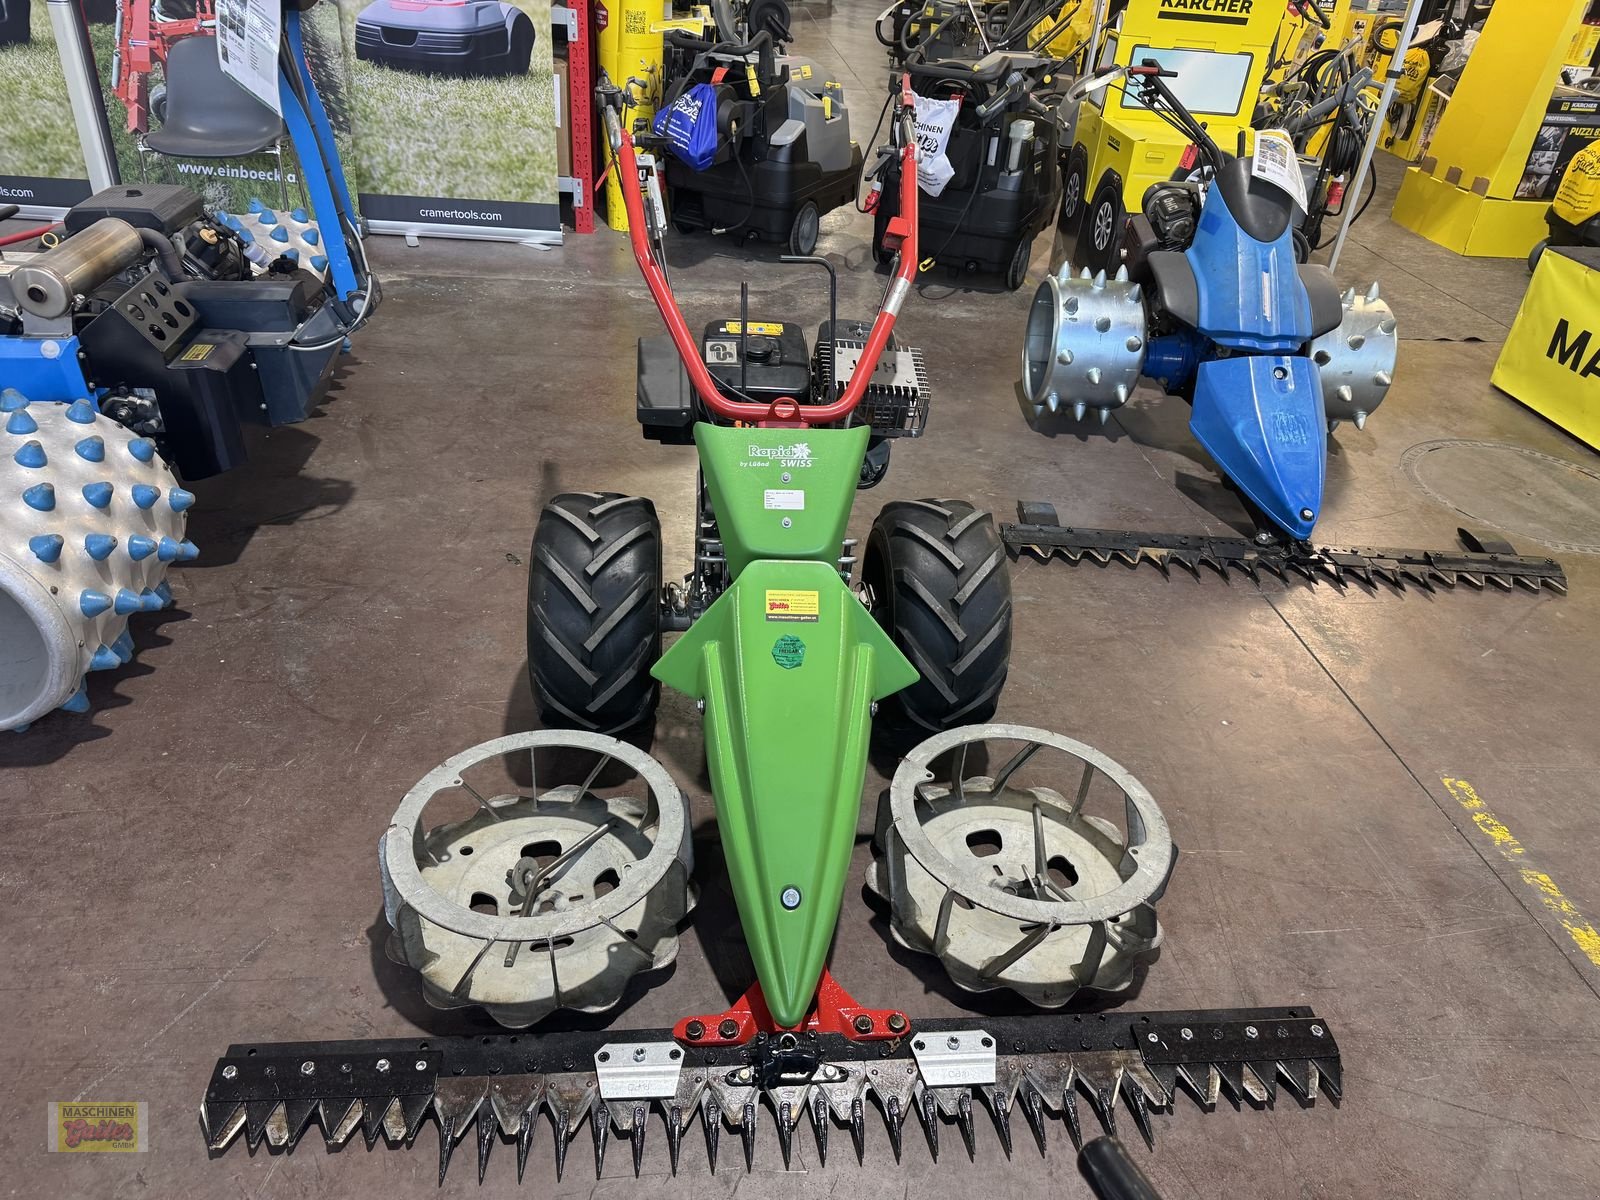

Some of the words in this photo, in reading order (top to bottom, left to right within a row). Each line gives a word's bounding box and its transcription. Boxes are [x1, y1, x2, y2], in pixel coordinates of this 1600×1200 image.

[914, 121, 944, 134] CHINEN
[1569, 127, 1593, 136] PUZZI
[0, 186, 34, 198] ls.com
[419, 208, 502, 221] cramertools.com
[748, 444, 795, 460] Rapid
[780, 459, 813, 468] SWISS
